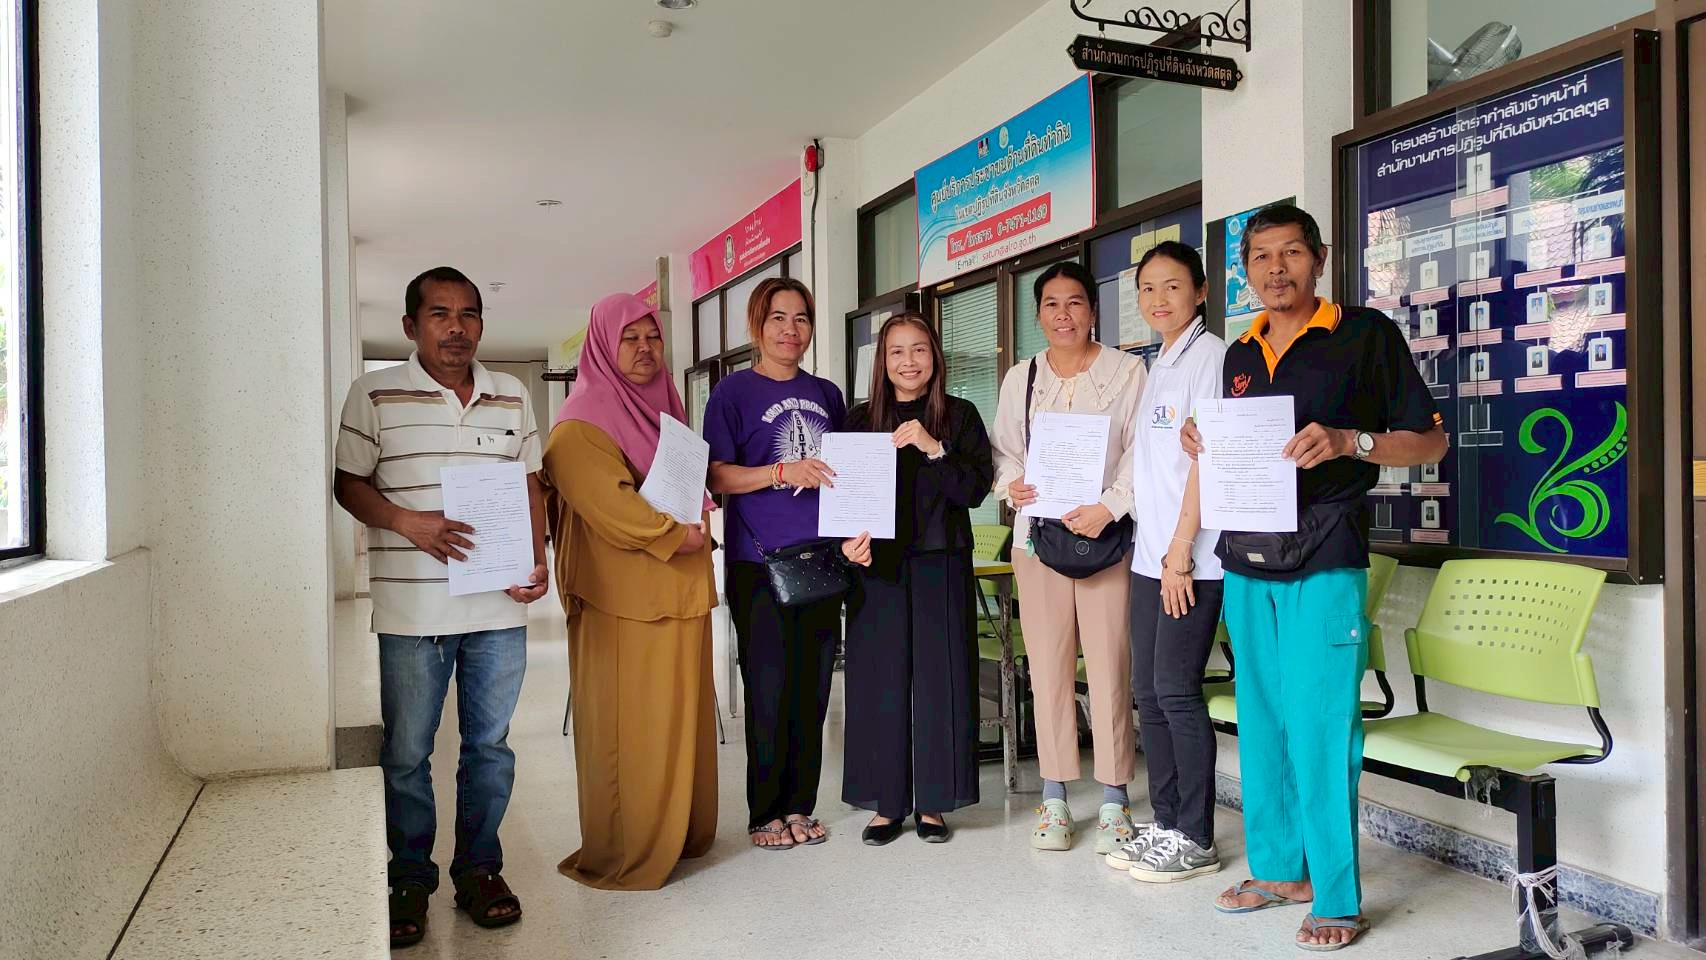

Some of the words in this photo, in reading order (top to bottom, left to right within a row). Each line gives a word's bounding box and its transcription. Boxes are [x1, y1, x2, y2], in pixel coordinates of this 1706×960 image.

[1081, 41, 1232, 87] สำนักงานการปฏิรูปที่ดินจังหวัดสตูล
[1376, 96, 1610, 178] สำนักงานการปฏิรูปที่ดินจังหวัดสตูล
[1391, 74, 1588, 154] โครงสร้างอัตรากำลังเจ้าหน้าที่
[781, 397, 799, 411] AND
